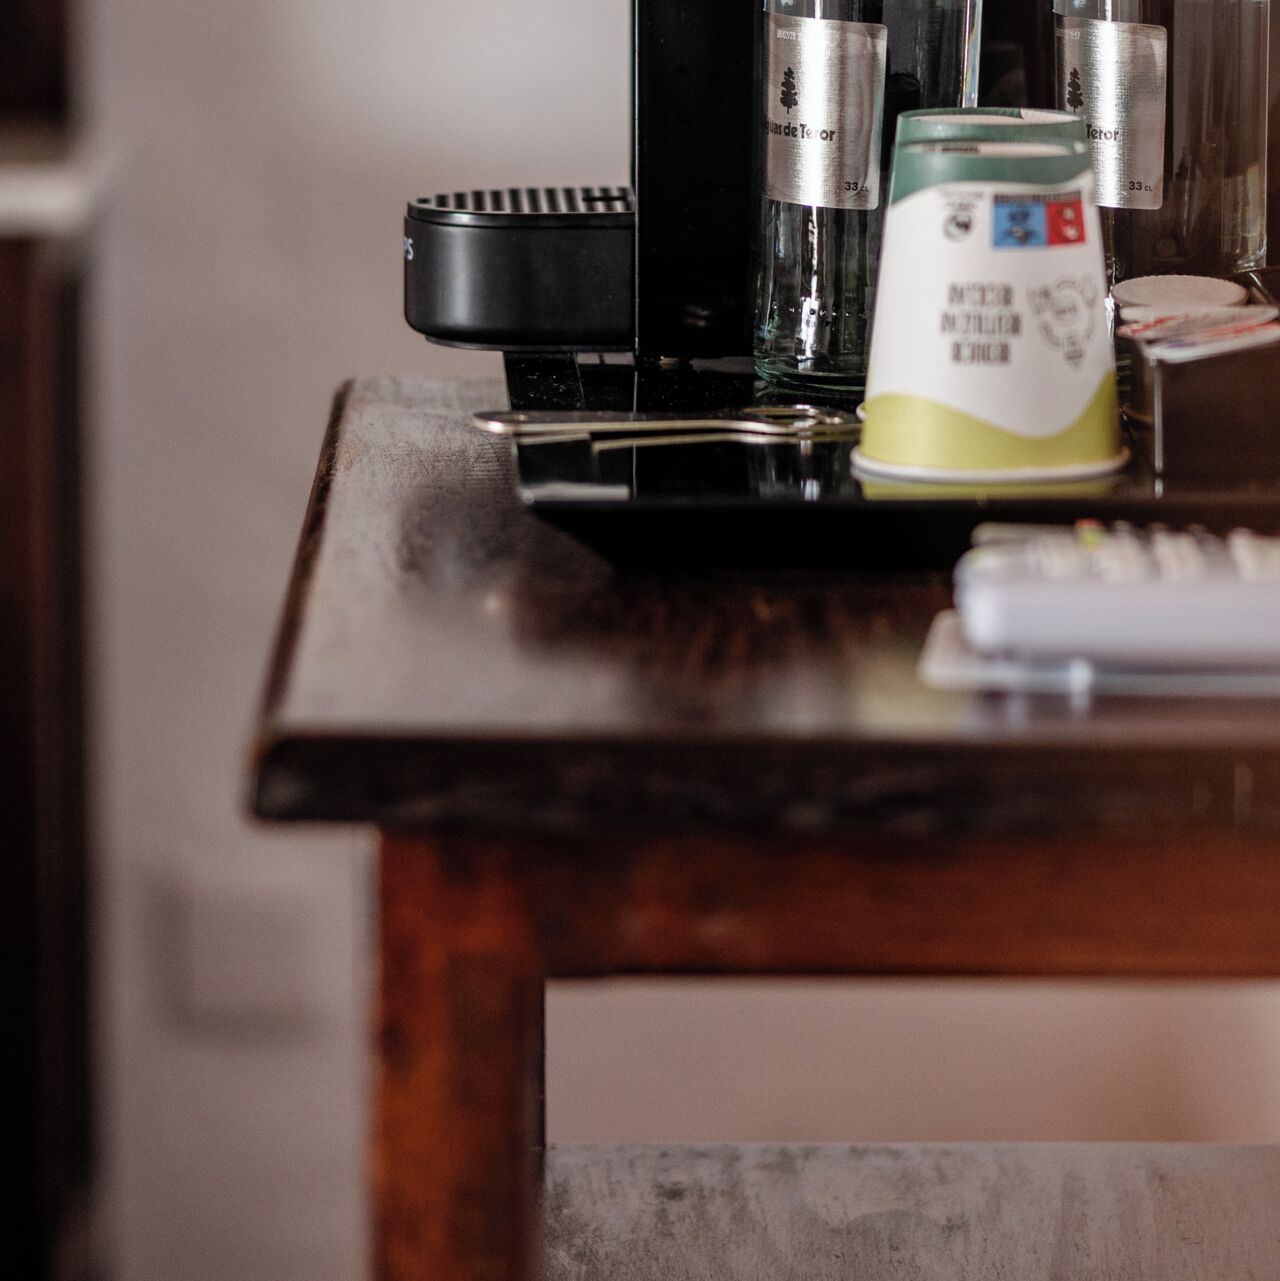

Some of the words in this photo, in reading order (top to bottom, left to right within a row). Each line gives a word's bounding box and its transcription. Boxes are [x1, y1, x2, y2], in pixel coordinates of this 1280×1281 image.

[783, 121, 798, 138] de
[799, 123, 835, 141] Teor
[1086, 123, 1119, 141] Teror
[844, 181, 859, 191] 33
[1128, 180, 1143, 191] 33
